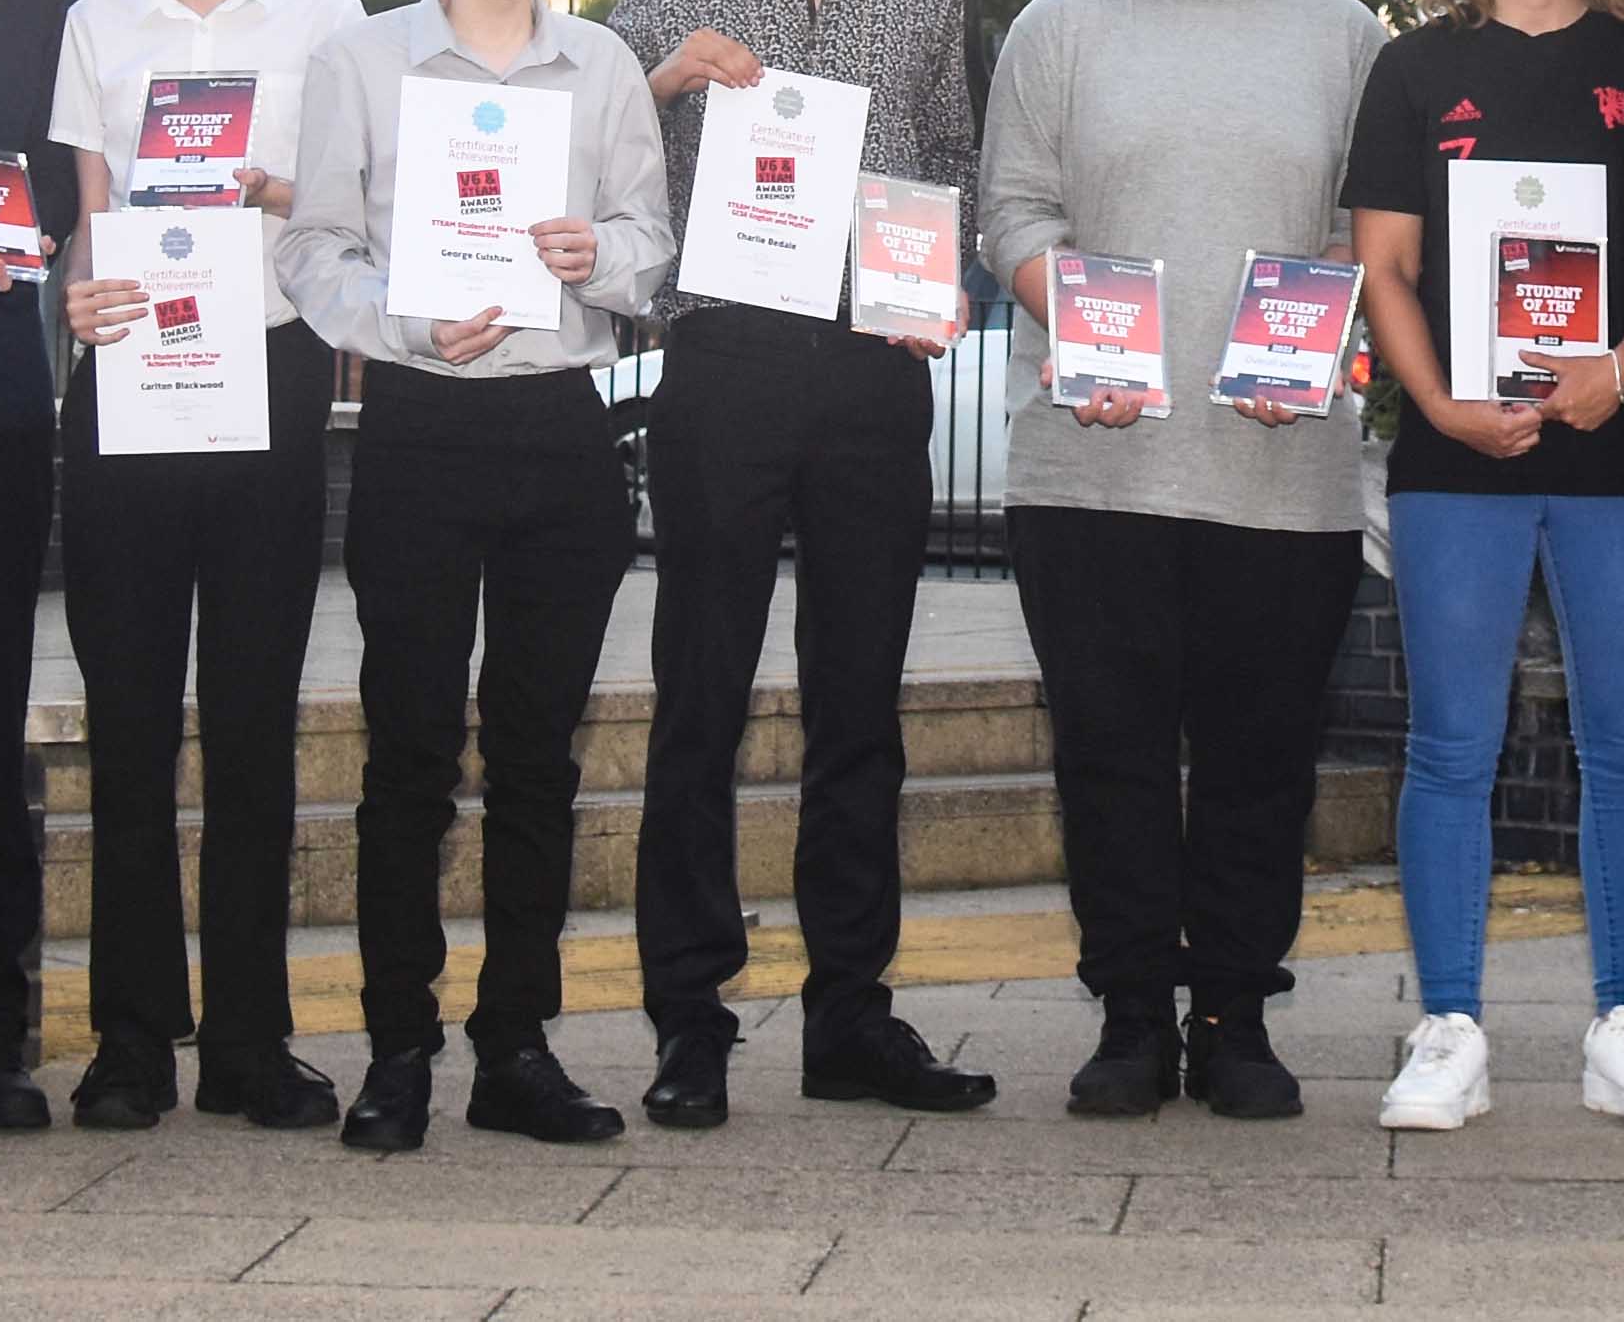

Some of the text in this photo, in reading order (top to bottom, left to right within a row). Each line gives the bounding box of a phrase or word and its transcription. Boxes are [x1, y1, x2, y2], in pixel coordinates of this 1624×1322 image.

[160, 113, 232, 125] STUDENT
[166, 125, 223, 135] OF THE
[752, 123, 816, 143] Certificate of
[171, 136, 214, 147] YEAR
[449, 138, 519, 154] Certificate of
[448, 149, 518, 165] Achievement
[759, 159, 792, 171] V6 &
[461, 172, 496, 186] V6 &
[756, 185, 795, 193] AWARDS
[460, 197, 502, 207] AWARDS
[756, 193, 795, 201] CEREMONY
[461, 206, 503, 215] CEREMONY
[458, 222, 486, 230] Student
[875, 220, 937, 243] STUDENT
[1497, 219, 1560, 230] Certificate of
[737, 232, 796, 250] Charlie Bedale
[882, 234, 931, 255] OF THE
[441, 249, 513, 263] George Culshaw
[889, 249, 924, 266] YEAR
[143, 269, 213, 280] Certificate of
[144, 280, 213, 291] Achievement
[1515, 283, 1582, 300] STUDENT
[1074, 295, 1141, 316] STUDENT
[1257, 297, 1329, 316] STUDENT
[1522, 298, 1575, 313] OF THE
[1081, 308, 1134, 326] OF THE
[1261, 310, 1319, 326] OF THE
[1529, 312, 1568, 326] YEAR
[160, 324, 202, 339] AWARDS
[1089, 322, 1128, 337] YEAR
[1266, 323, 1308, 338] YEAR
[162, 333, 203, 346] CEREMONY
[141, 381, 224, 391] Carlton Blackwood
